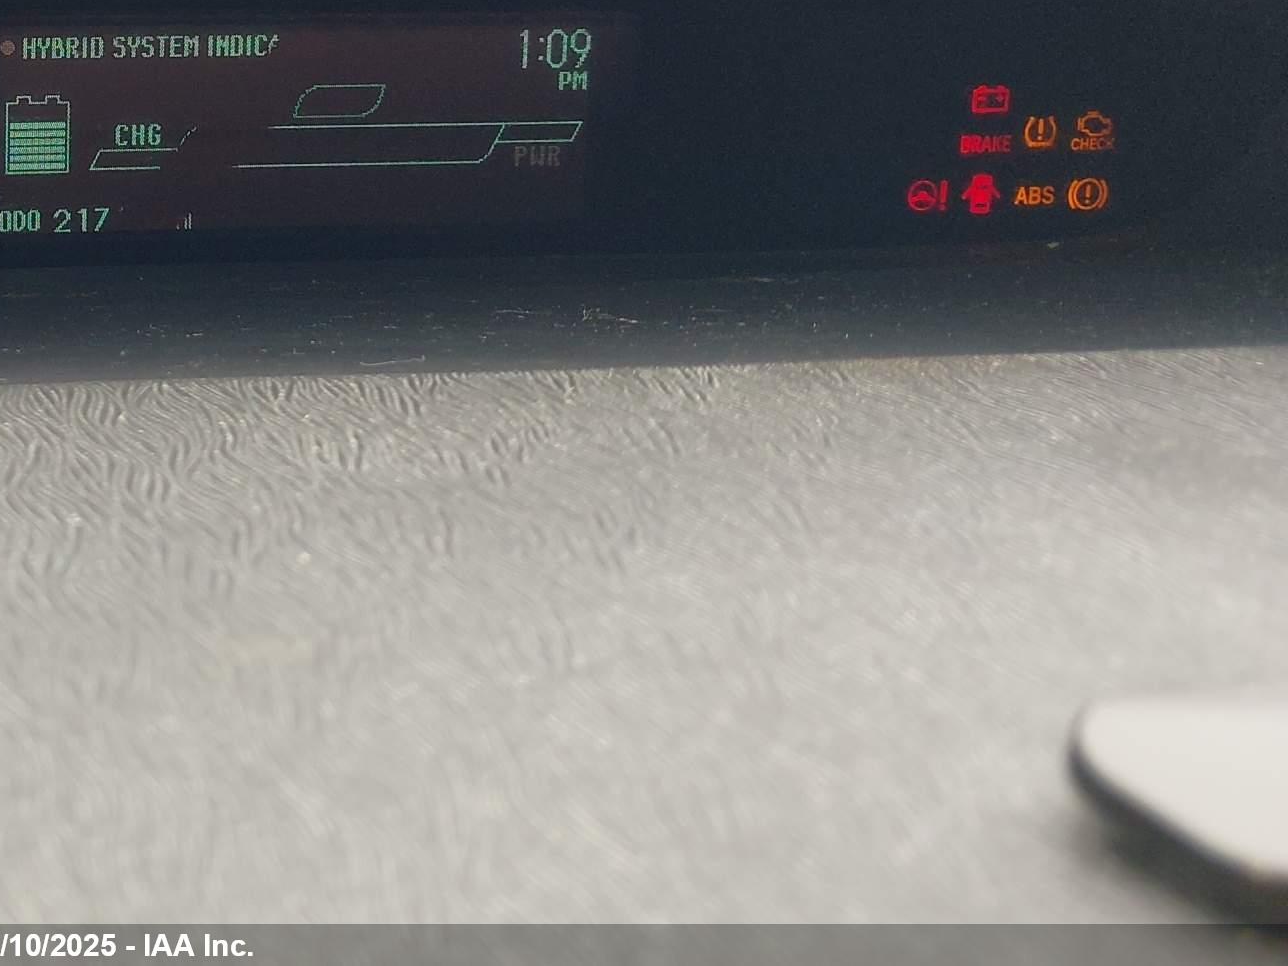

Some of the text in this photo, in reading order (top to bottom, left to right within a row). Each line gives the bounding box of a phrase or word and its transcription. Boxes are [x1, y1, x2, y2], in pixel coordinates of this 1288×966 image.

[22, 36, 104, 59] HYBRID
[112, 35, 200, 58] SYSTEM
[519, 28, 592, 69] 1:09
[558, 70, 588, 90] PM
[114, 123, 162, 146] CHG
[959, 134, 1012, 155] BRAKE
[1070, 137, 1115, 151] CHECK
[514, 145, 561, 167] PWR
[1014, 185, 1055, 205] ABS
[53, 207, 110, 233] 217
